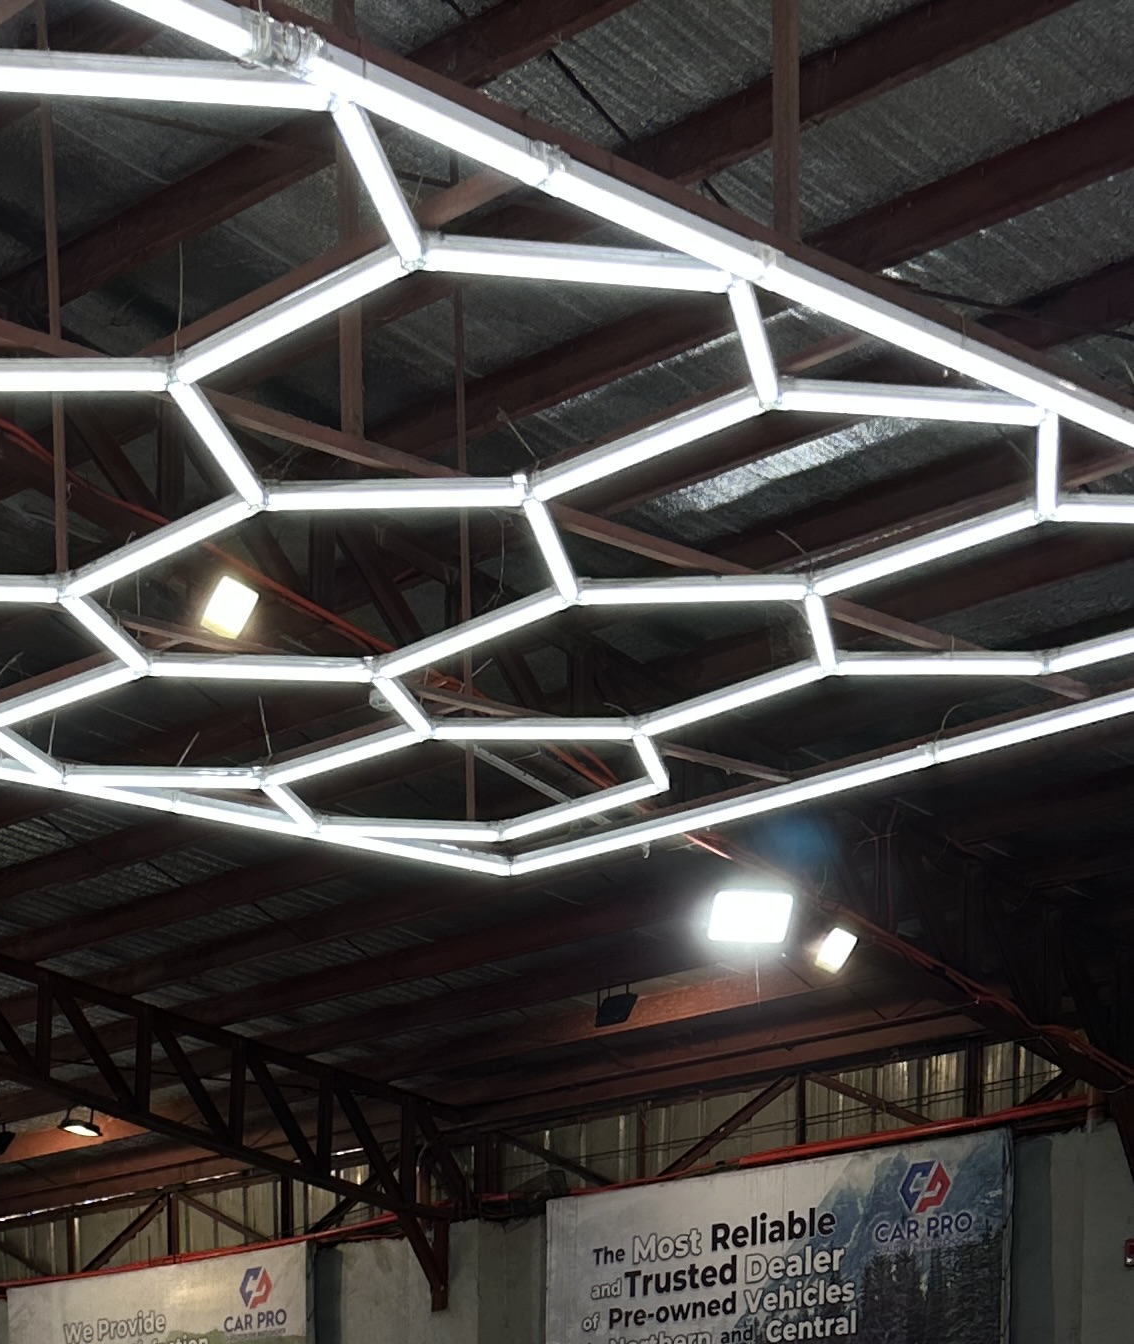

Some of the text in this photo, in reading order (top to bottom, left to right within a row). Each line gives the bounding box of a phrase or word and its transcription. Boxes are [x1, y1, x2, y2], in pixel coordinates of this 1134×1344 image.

[592, 1207, 836, 1266] The Most Reliable
[874, 1212, 972, 1243] CAR PRO
[590, 1245, 845, 1299] and Trusted Dealer
[224, 1308, 287, 1333] CAR PRO
[582, 1279, 856, 1332] of Pre-owned Vehicles
[97, 1310, 166, 1342] Provide
[766, 1309, 857, 1344] Central
